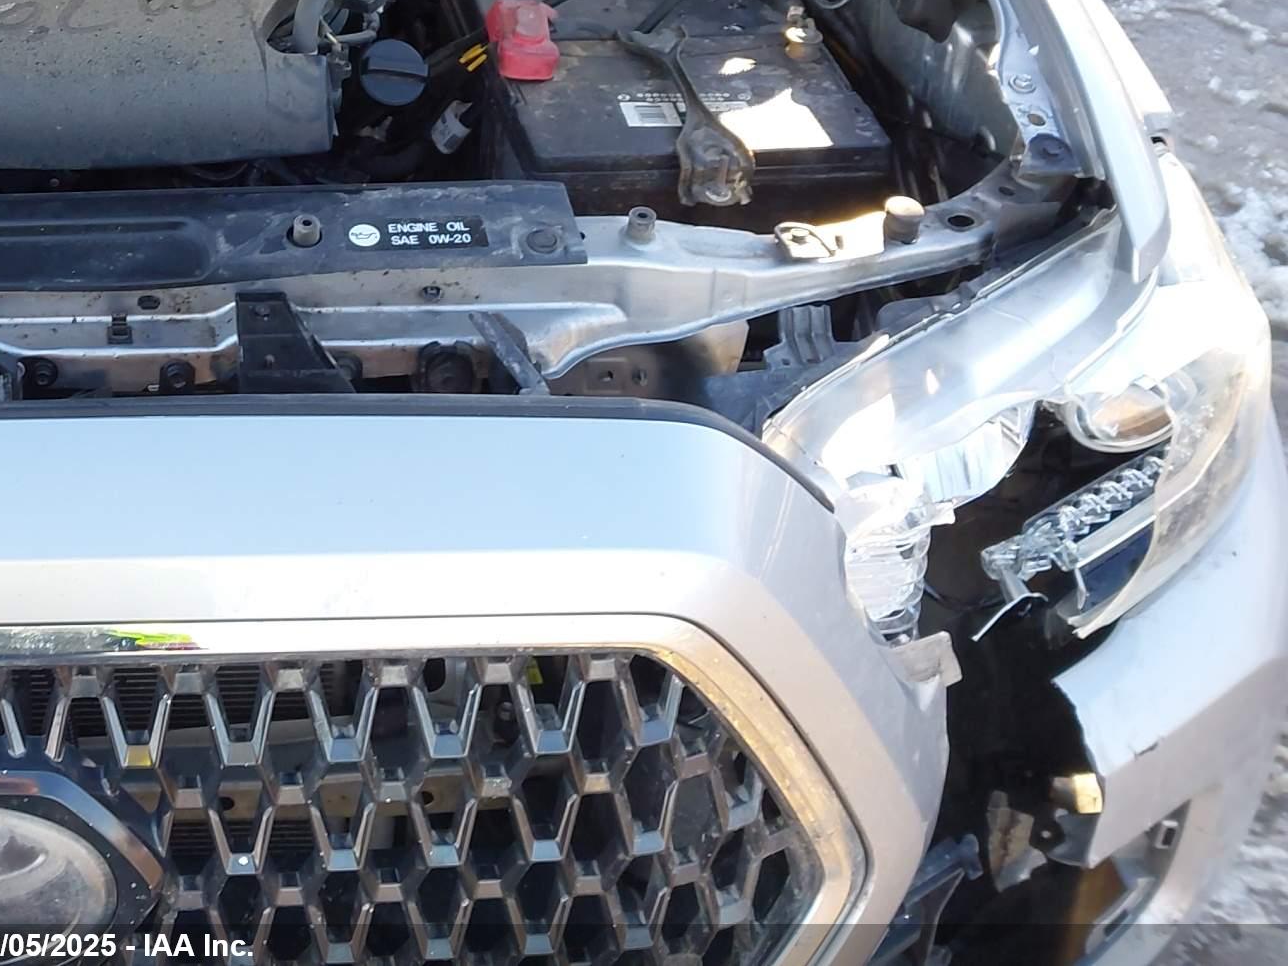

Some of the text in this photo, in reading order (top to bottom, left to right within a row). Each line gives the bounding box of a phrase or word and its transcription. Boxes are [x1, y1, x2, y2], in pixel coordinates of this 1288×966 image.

[388, 221, 470, 233] ENGINE OIL
[390, 233, 471, 245] SAE 0W-20
